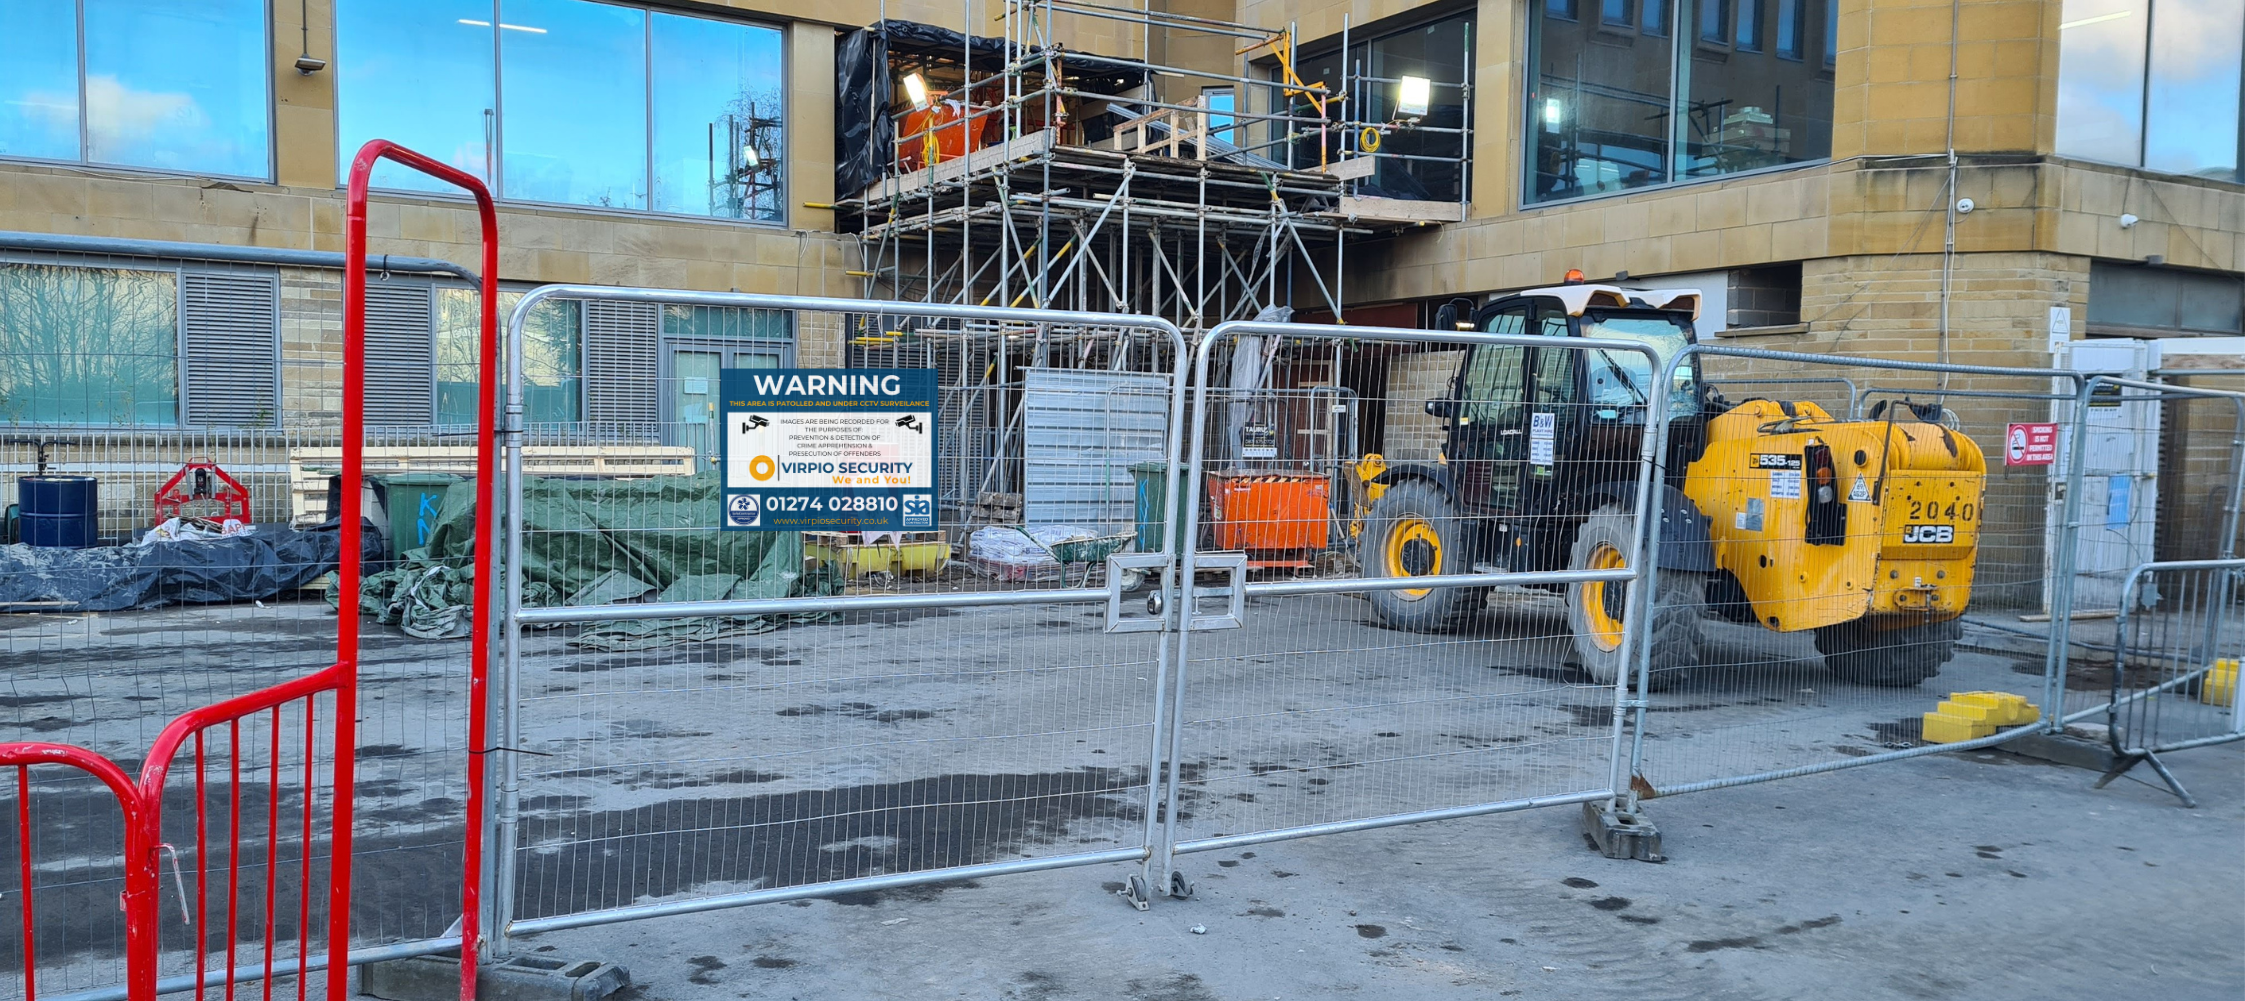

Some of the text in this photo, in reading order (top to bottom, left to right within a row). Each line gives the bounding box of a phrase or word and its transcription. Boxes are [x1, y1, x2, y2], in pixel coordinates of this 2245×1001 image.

[1533, 415, 1554, 428] B&W
[1909, 501, 1974, 522] 2040
[1904, 525, 1954, 543] JCB
